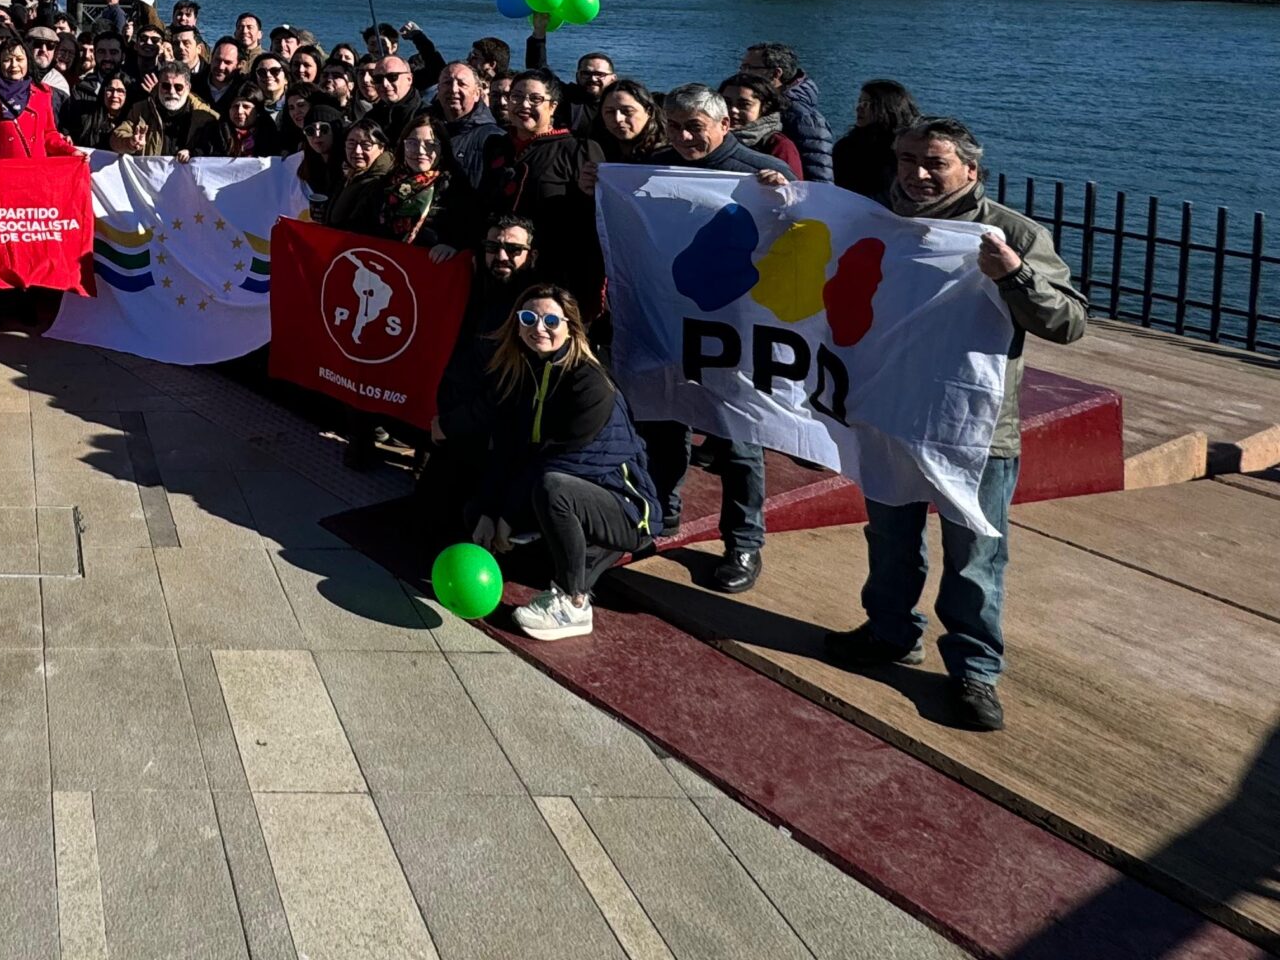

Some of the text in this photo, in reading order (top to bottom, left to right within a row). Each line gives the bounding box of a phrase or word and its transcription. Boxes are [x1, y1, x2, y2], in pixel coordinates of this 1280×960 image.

[0, 231, 63, 244] DE CHILE
[319, 366, 358, 393] REGIONAL
[359, 383, 382, 400] LOS
[682, 316, 850, 428] PPD
